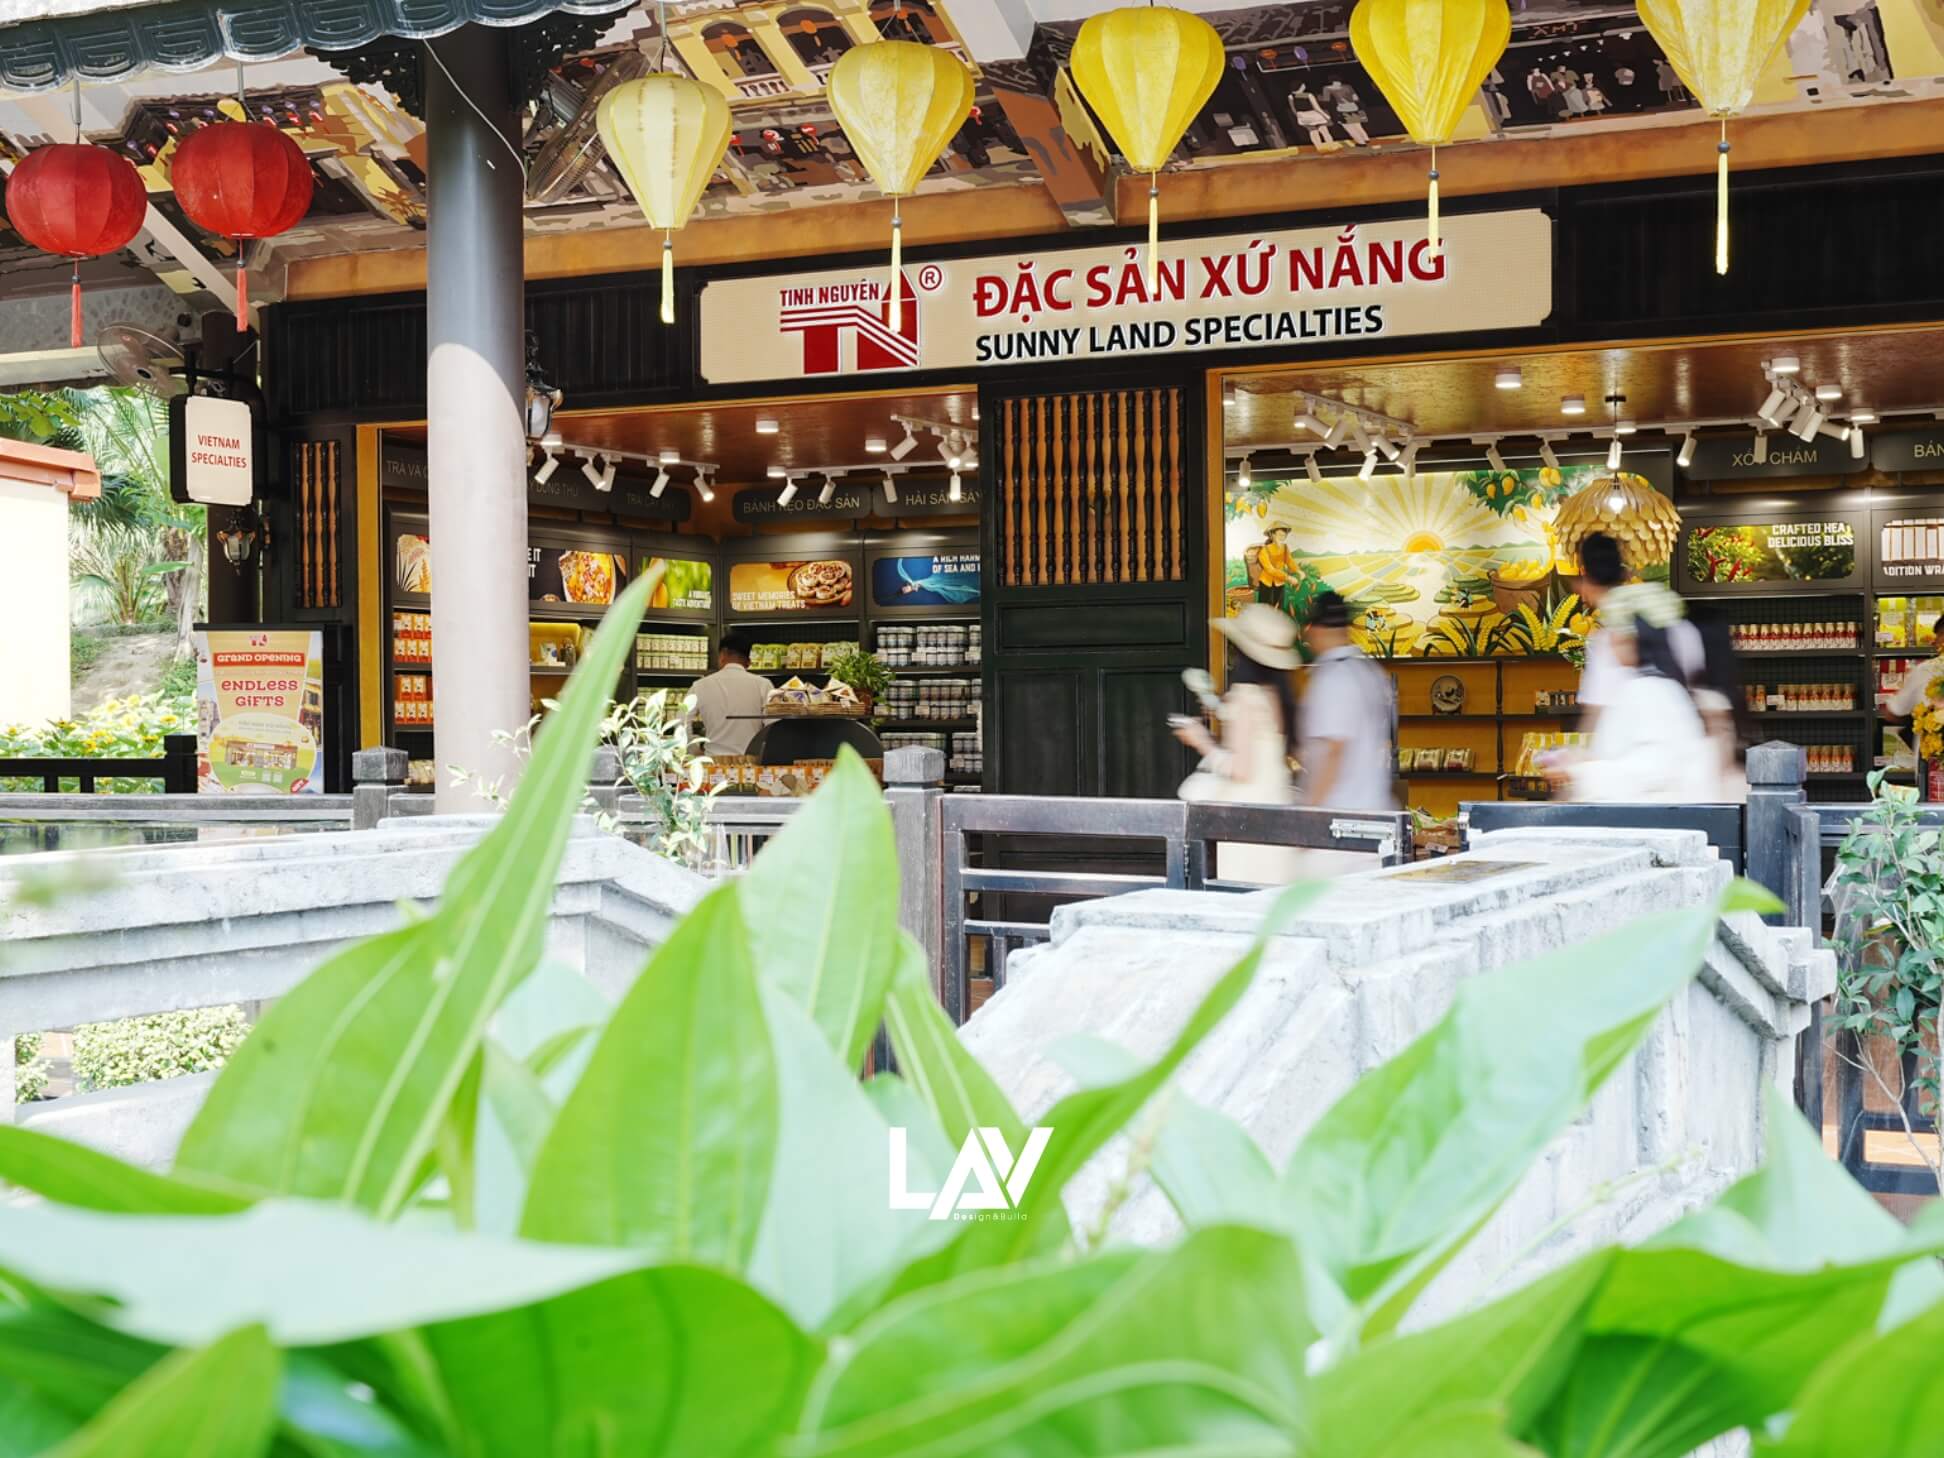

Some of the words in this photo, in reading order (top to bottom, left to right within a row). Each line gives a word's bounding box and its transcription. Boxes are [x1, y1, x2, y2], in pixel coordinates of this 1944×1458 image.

[973, 260, 1073, 324] ĐẶC
[1086, 247, 1185, 308] SẢN
[1200, 239, 1276, 299] XỨ
[1289, 223, 1445, 291] NẮNG
[818, 278, 880, 304] NGUYÊN
[976, 327, 1081, 361] SUNNY
[1089, 320, 1175, 353] LAND
[1184, 304, 1383, 345] SPECIALTIES
[197, 434, 240, 449] VIETNAM
[191, 452, 247, 468] SPECIALTIES
[1772, 524, 1820, 535] CRAFTED
[1767, 535, 1821, 548] DELICIOUS
[1823, 534, 1854, 546] BLISS
[932, 564, 942, 574] OF
[944, 564, 958, 573] SEA
[960, 563, 976, 572] AND
